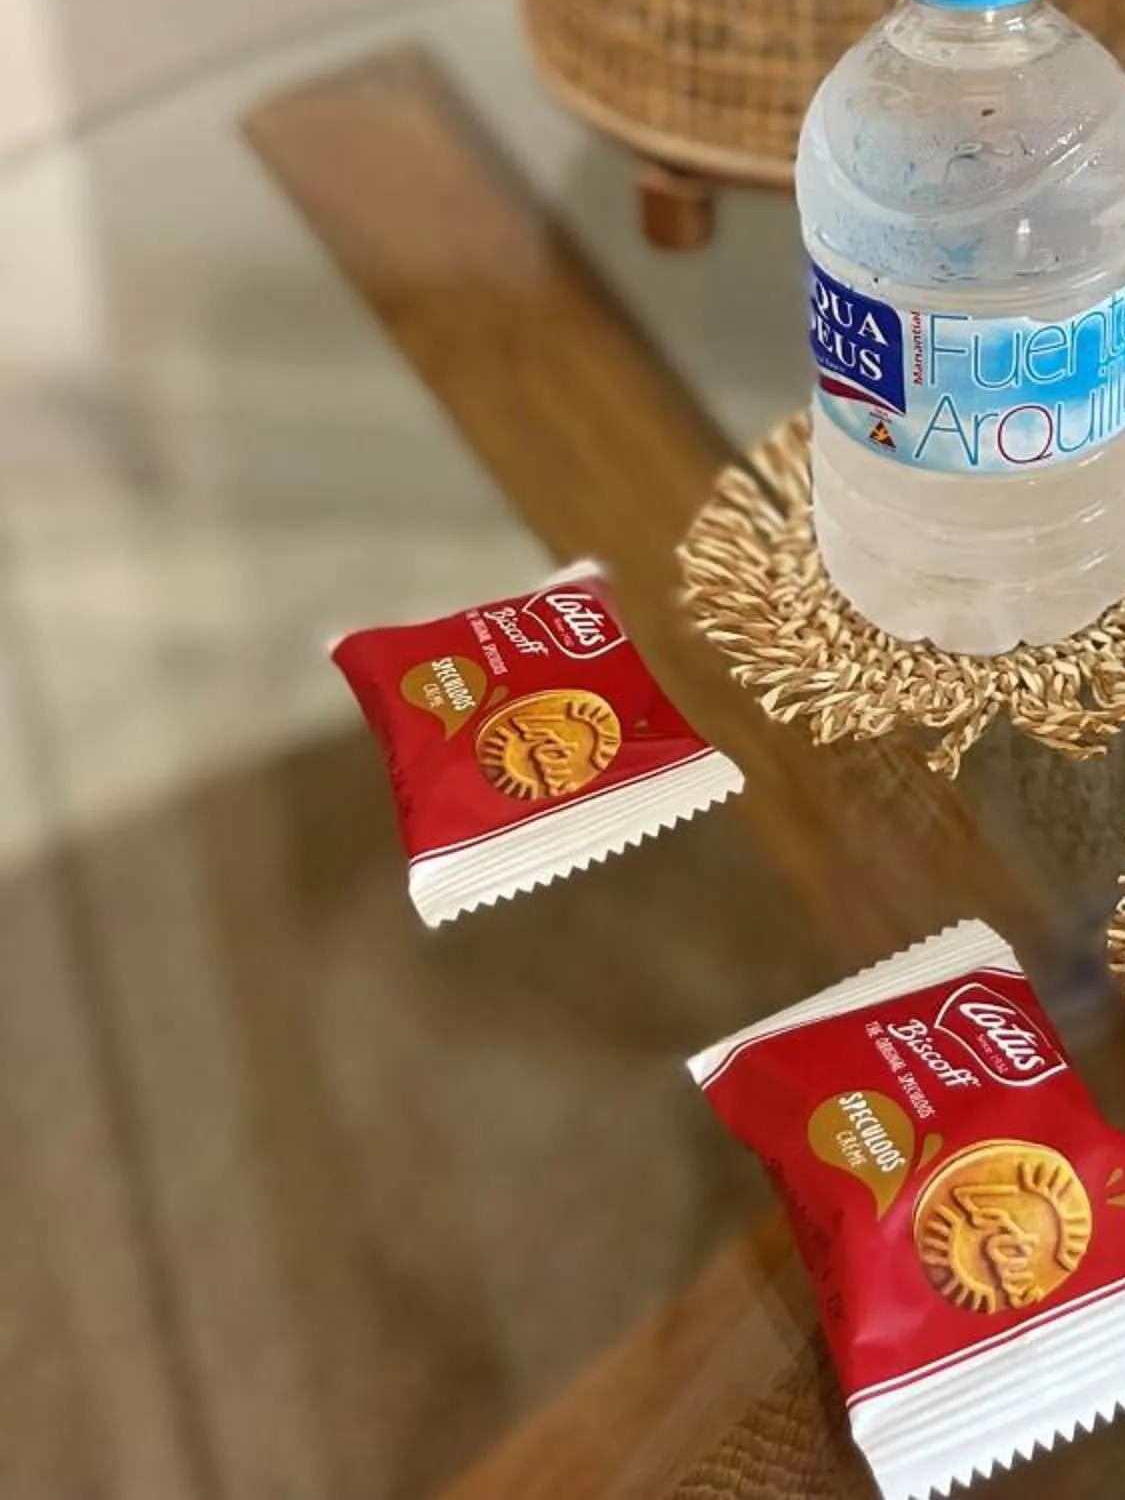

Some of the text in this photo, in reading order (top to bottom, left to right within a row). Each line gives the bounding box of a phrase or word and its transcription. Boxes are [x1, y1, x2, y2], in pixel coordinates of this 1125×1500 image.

[815, 278, 889, 348] QUA
[909, 310, 923, 385] Manantial
[483, 607, 545, 654] Biscoff
[545, 593, 606, 646] Lotus
[887, 1018, 978, 1087] Biscoff
[959, 1002, 1045, 1070] Lotus
[838, 1092, 906, 1172] SPECULOOS
